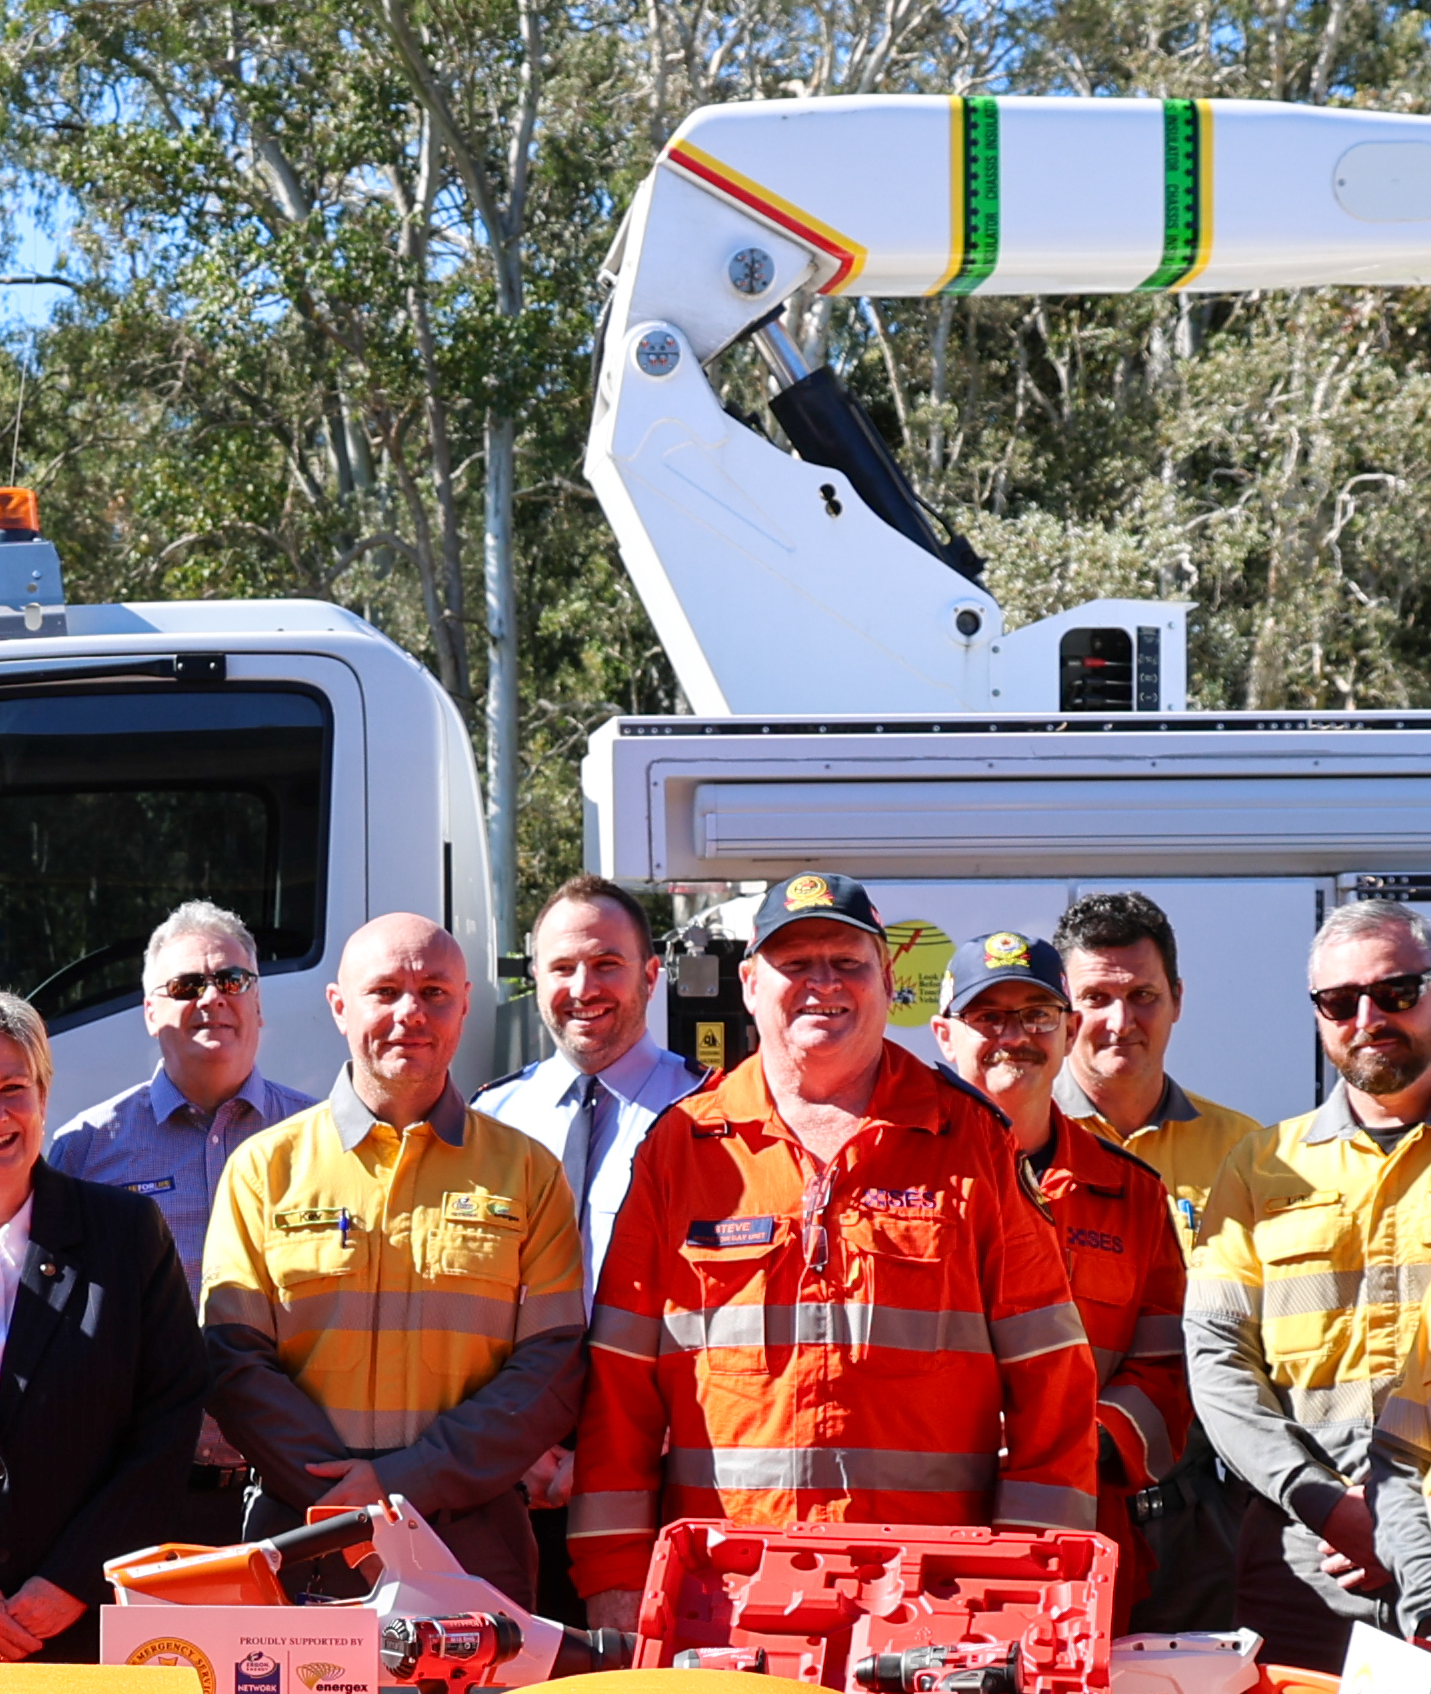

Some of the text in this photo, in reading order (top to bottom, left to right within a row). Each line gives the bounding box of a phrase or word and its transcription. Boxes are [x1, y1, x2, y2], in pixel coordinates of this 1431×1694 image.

[888, 1190, 934, 1208] SES
[1088, 1231, 1124, 1254] SES
[239, 1637, 364, 1646] PROUDLY SUPPORTED BY
[238, 1684, 277, 1693] NETWORK
[316, 1682, 369, 1694] energex
